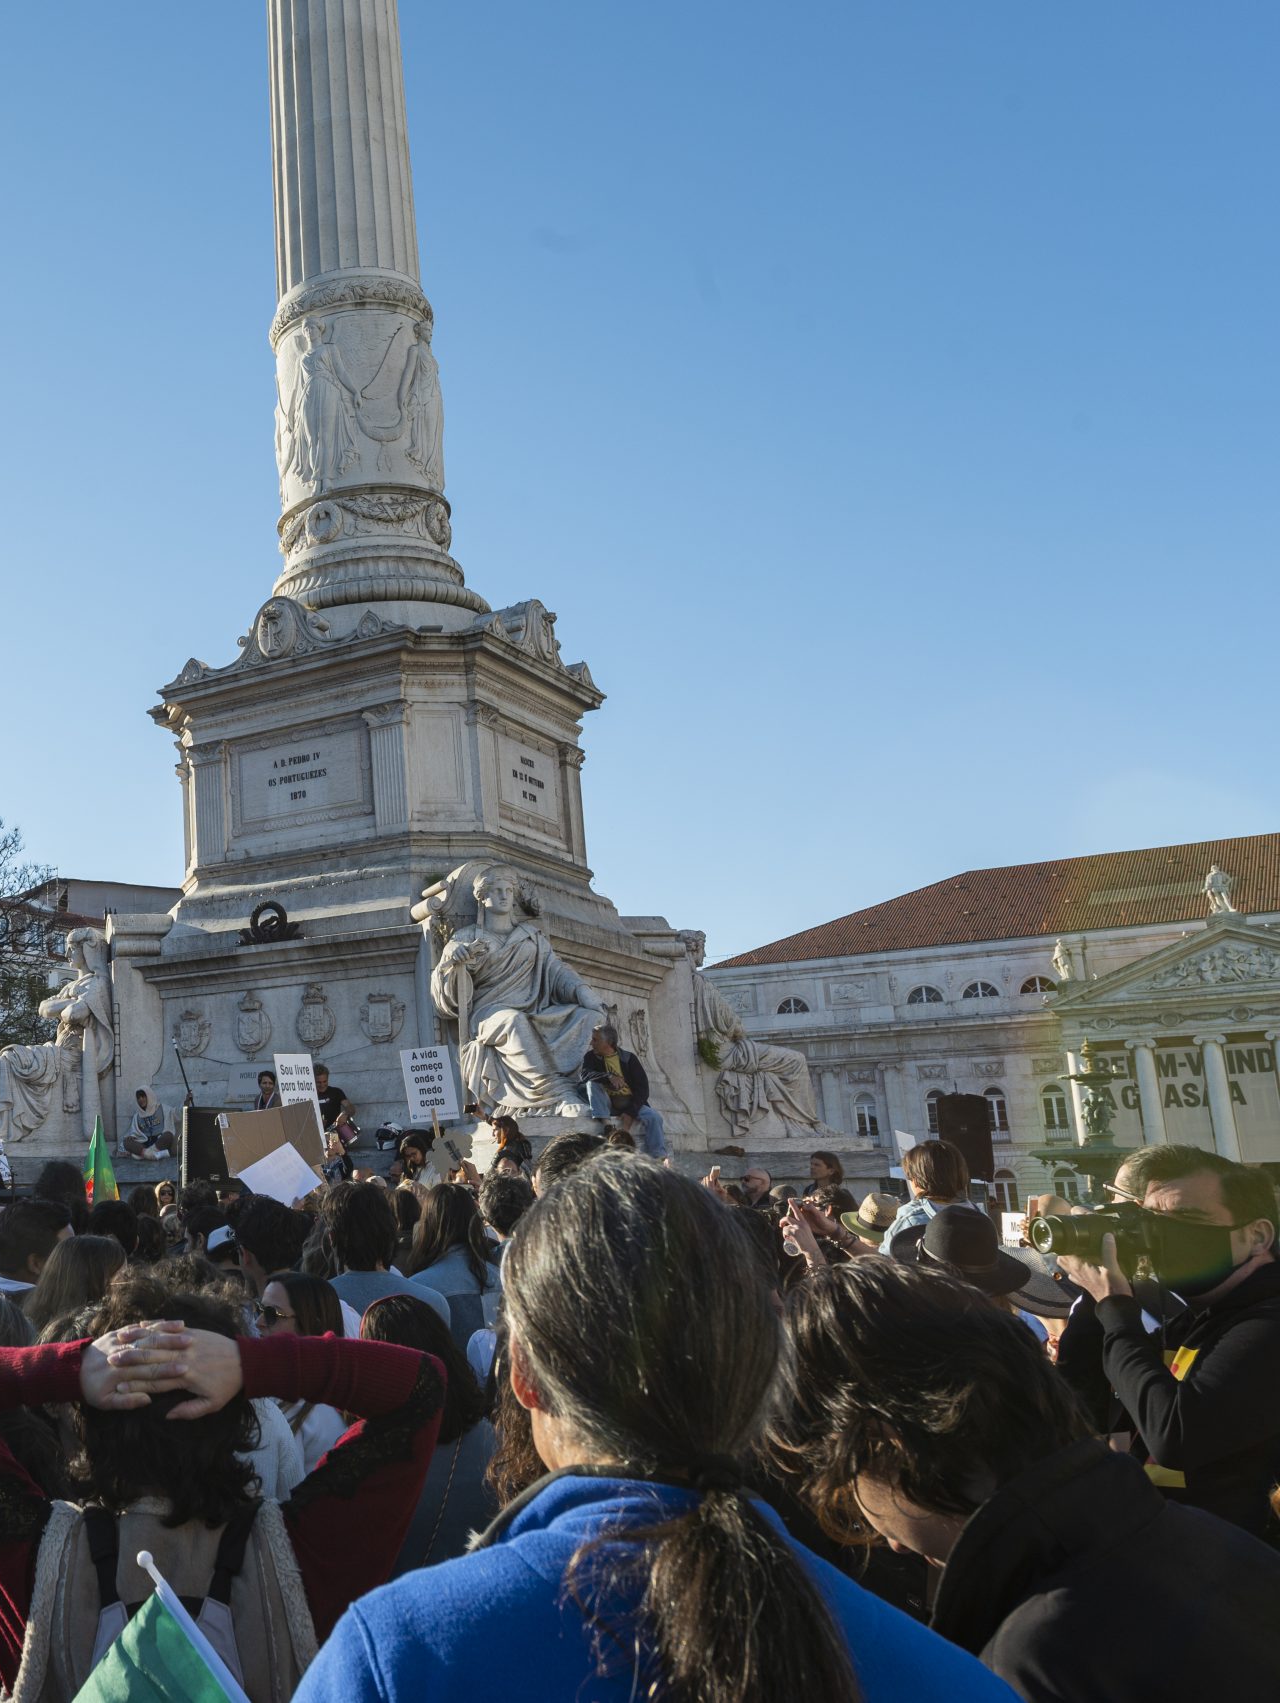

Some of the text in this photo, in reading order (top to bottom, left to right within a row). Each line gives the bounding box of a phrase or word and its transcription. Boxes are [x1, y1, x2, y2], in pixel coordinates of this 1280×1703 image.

[273, 760, 278, 768] A
[288, 754, 310, 766] PEDRO
[313, 752, 320, 760] IV
[268, 768, 327, 787] OS PORTUGUEZES
[290, 790, 307, 800] 1870
[412, 1050, 438, 1060] A vida
[280, 1064, 310, 1075] Sou livre
[410, 1061, 443, 1072] começa
[414, 1074, 443, 1084] onde o
[281, 1080, 315, 1093] para falar,
[419, 1085, 443, 1095] medo
[420, 1098, 445, 1107] acaba
